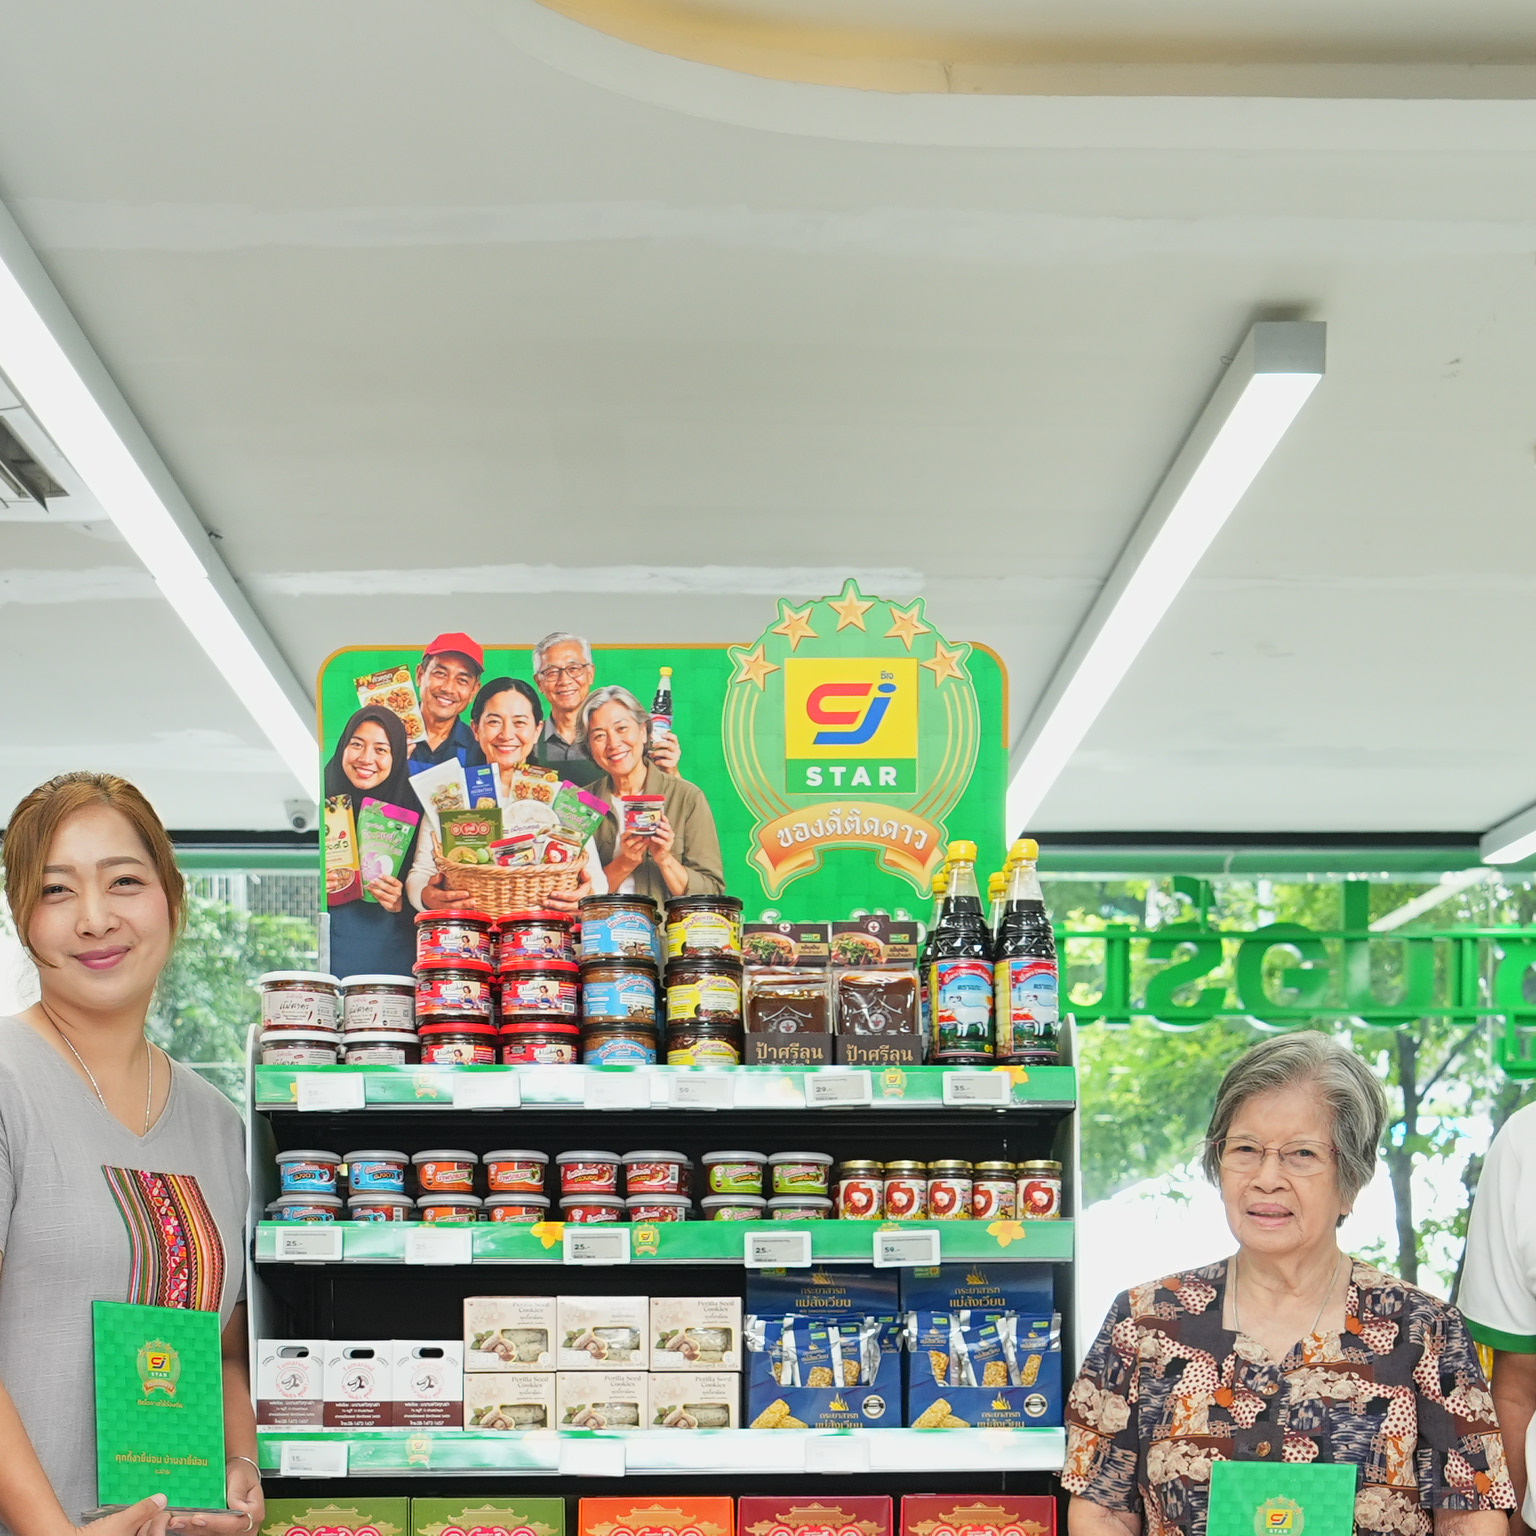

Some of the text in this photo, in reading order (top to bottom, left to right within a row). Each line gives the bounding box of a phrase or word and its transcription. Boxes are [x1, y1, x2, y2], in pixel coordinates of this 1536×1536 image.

[806, 766, 897, 787] STAR
[777, 807, 929, 850] ของดีติดดาว
[756, 1041, 824, 1061] ป้าศรีลุน
[846, 1043, 914, 1063] ป้าศรีลุน
[795, 1296, 852, 1308] แม่สังเวียน
[949, 1296, 1006, 1307] แม่สังเวียน
